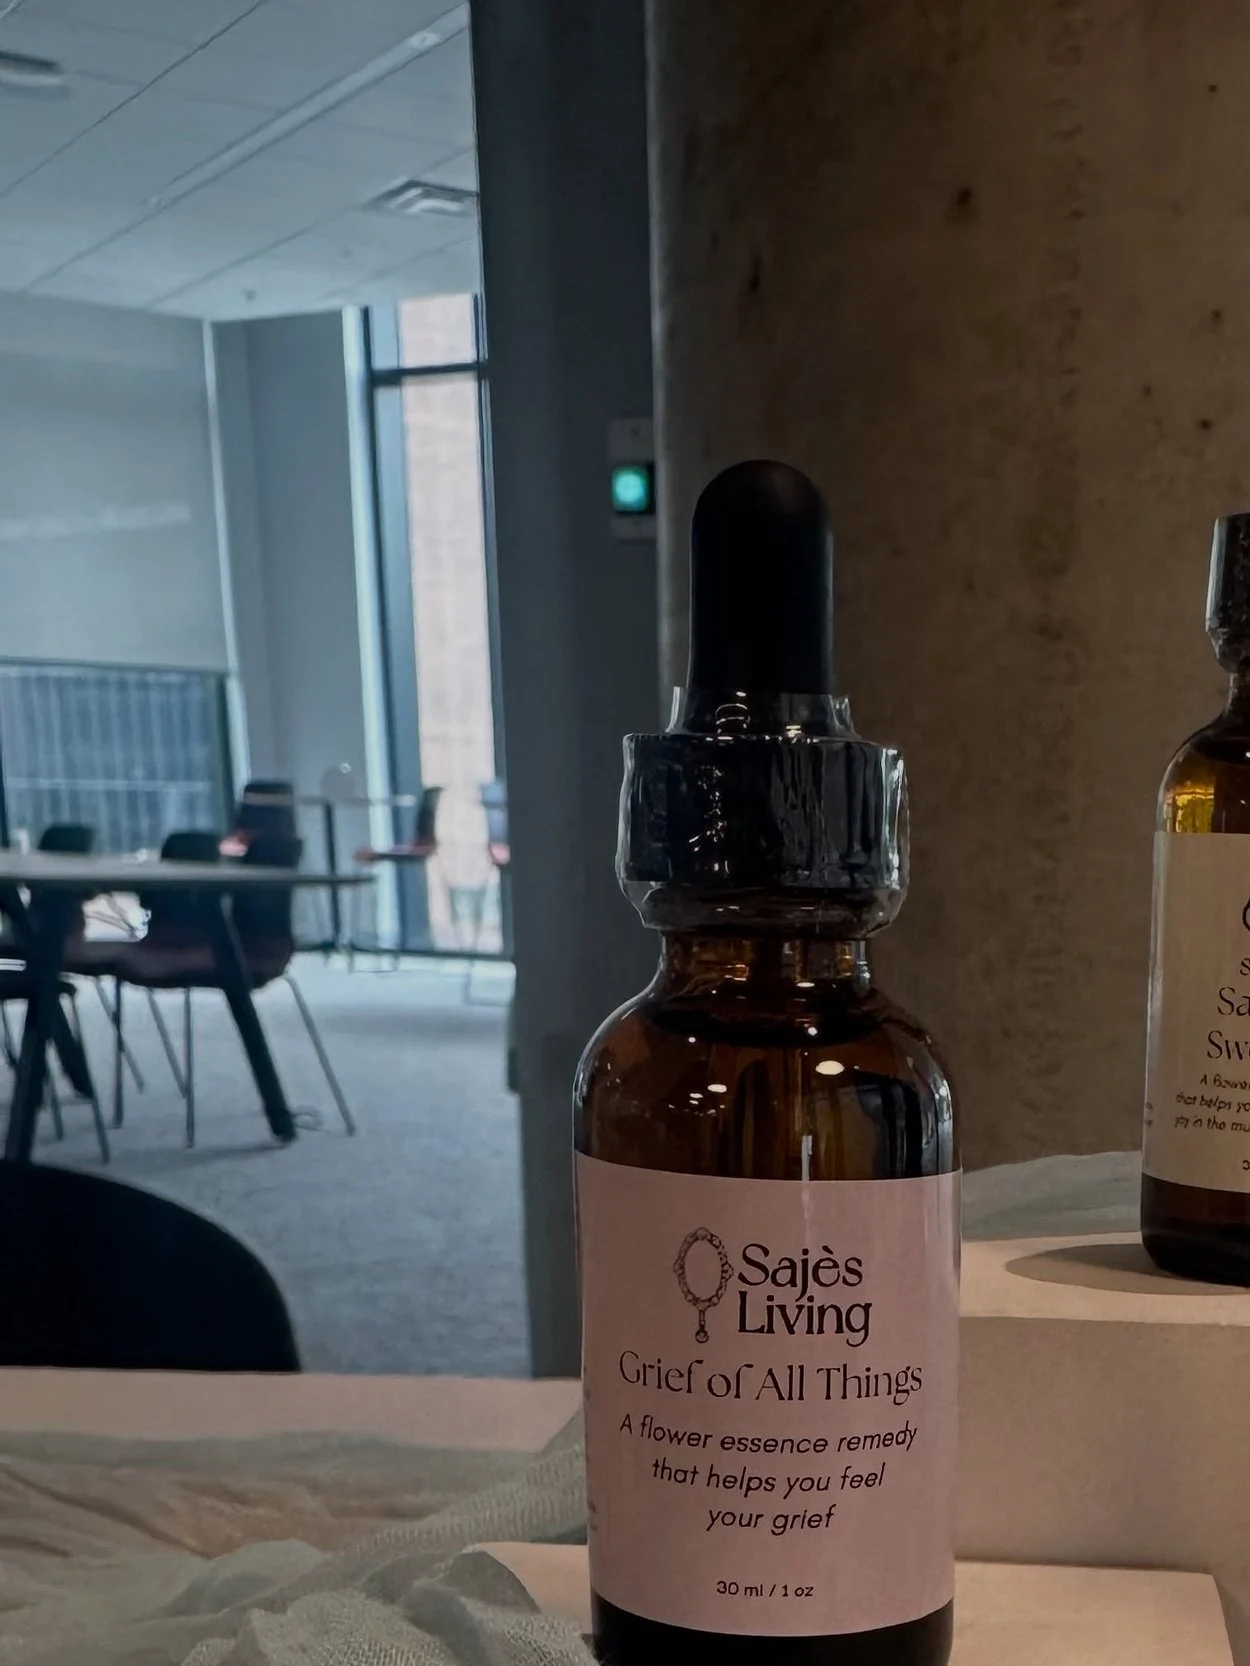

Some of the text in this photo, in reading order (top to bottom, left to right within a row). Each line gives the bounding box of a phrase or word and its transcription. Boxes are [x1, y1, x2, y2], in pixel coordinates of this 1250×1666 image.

[1200, 1074, 1208, 1086] A
[1200, 1095, 1232, 1111] helps
[1207, 1117, 1226, 1131] the
[737, 1243, 864, 1302] Sajès
[737, 1290, 873, 1348] Living
[619, 1350, 923, 1406] Grief of All Things
[619, 1413, 918, 1454] A flower essence remedy
[652, 1457, 886, 1499] that helps you feel
[705, 1504, 837, 1536] your grief
[716, 1581, 814, 1598] 30 ml / 1 oz
